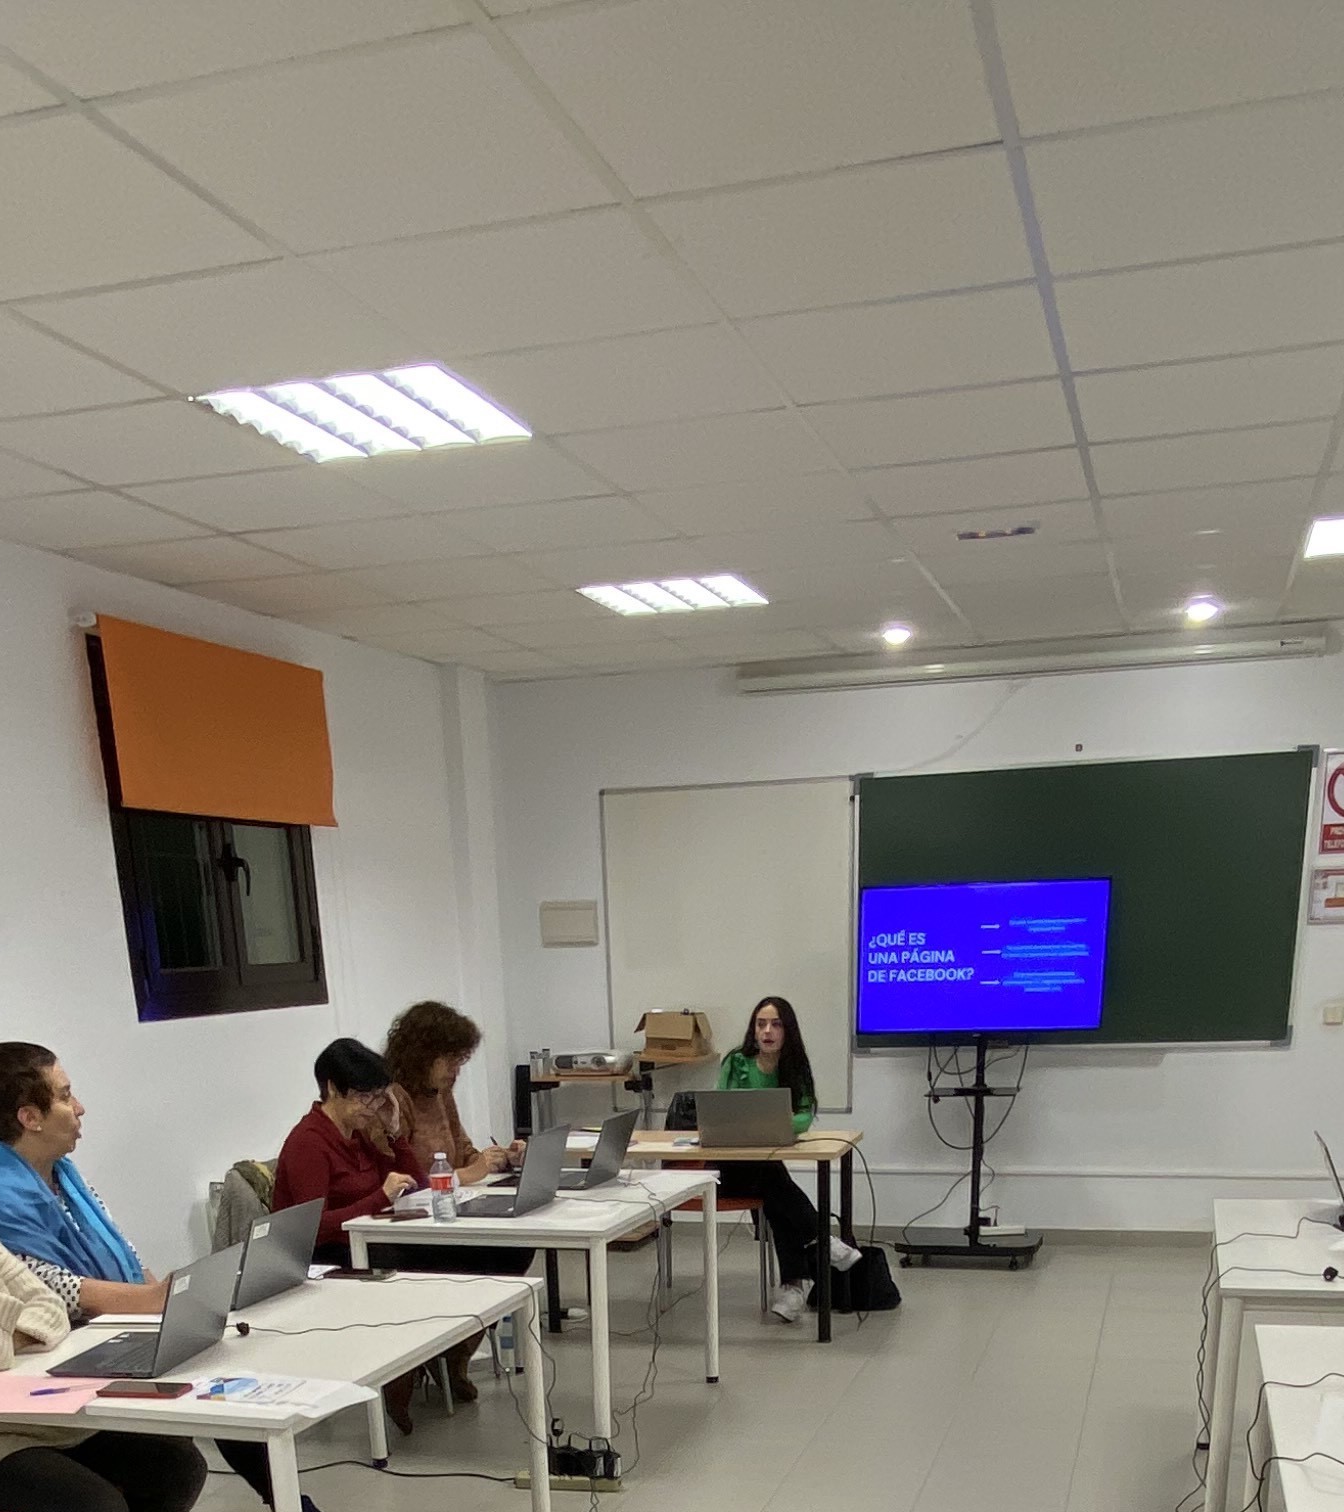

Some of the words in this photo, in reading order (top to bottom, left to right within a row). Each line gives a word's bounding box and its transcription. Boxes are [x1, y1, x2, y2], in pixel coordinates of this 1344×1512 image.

[868, 930, 905, 948] ¿QUÉ
[908, 932, 926, 947] ES
[868, 951, 898, 965] UNA
[902, 948, 955, 964] PÁGINA
[868, 969, 887, 983] DE
[889, 967, 974, 982] FACEBOOK?
